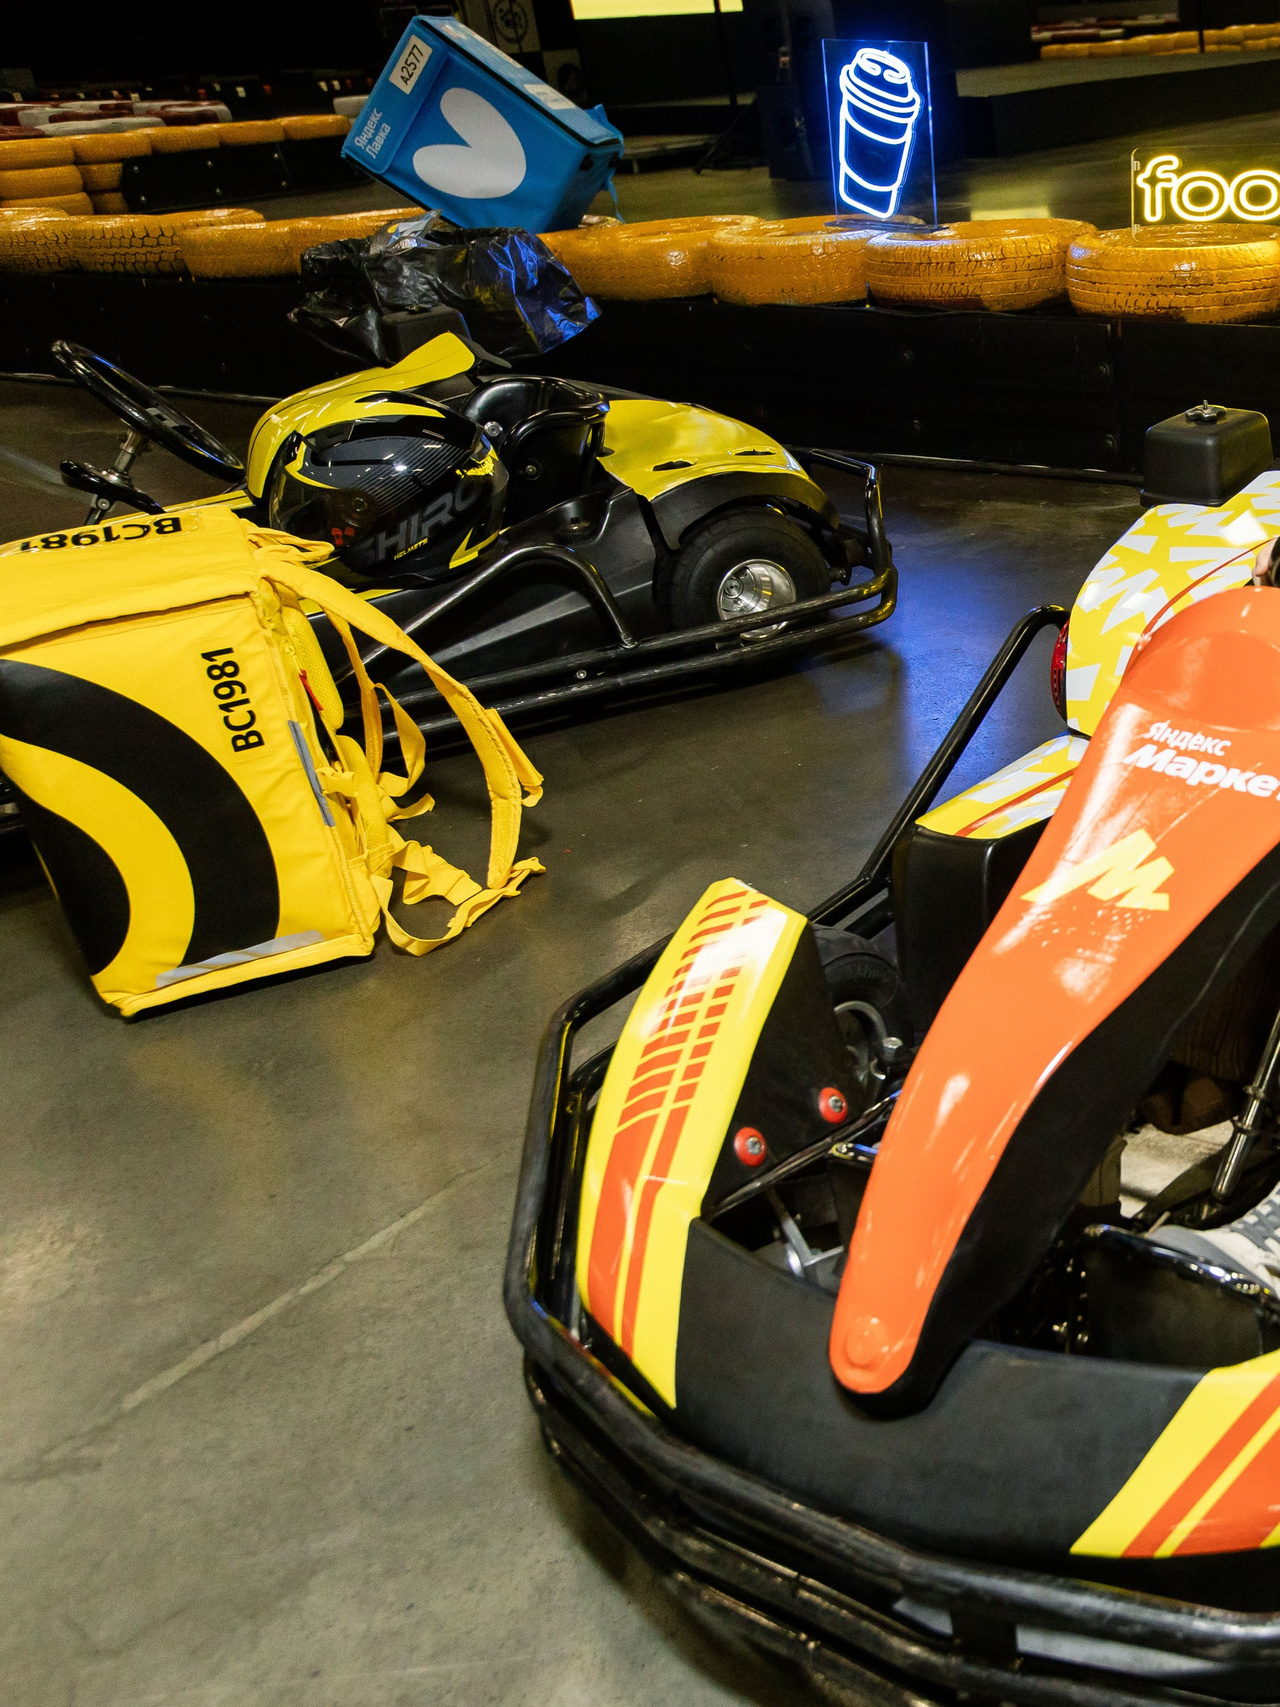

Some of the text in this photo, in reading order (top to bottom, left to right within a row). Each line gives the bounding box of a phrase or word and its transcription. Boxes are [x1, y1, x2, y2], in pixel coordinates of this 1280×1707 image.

[400, 44, 424, 86] A2577
[354, 107, 383, 150] Яндекс
[365, 122, 391, 159] Лавка
[20, 516, 183, 551] BC1981
[353, 474, 483, 565] SHIRO
[393, 537, 429, 560] HELMETS
[200, 647, 266, 753] BC1981
[1143, 721, 1232, 757] Яндекс
